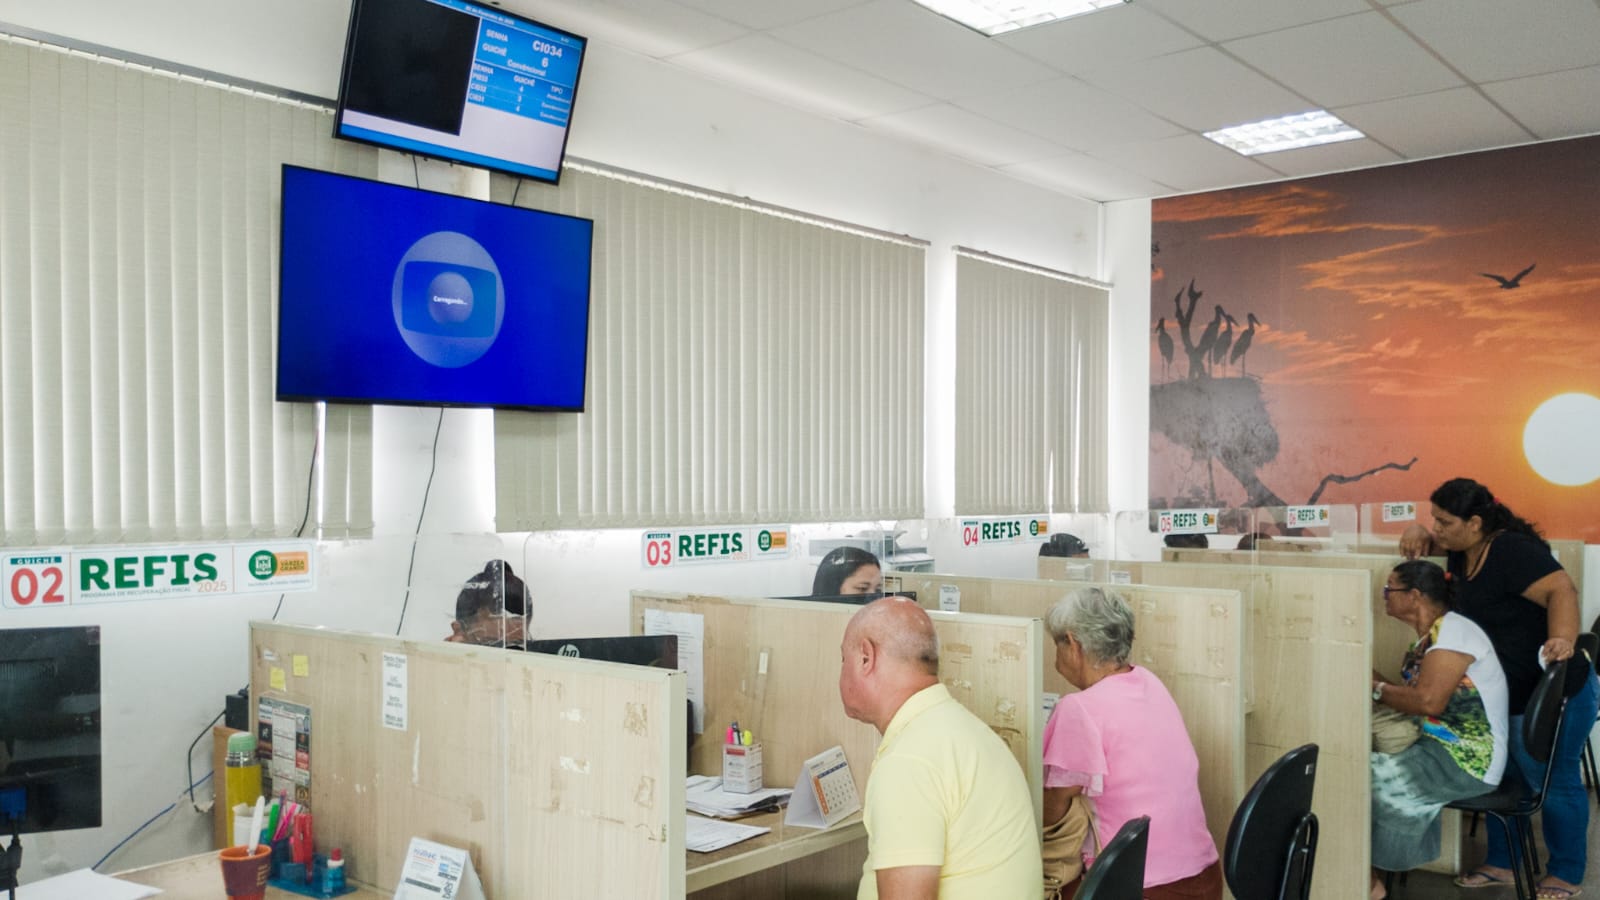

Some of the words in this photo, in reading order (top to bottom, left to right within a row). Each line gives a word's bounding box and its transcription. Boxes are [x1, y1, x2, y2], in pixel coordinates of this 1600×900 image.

[486, 29, 508, 42] SENHA
[532, 40, 562, 58] CI034
[541, 57, 549, 68] 6
[472, 63, 494, 75] SENHA
[551, 85, 563, 94] TIPO
[1173, 513, 1197, 527] REFIS
[1297, 509, 1315, 521] REFIS
[963, 526, 979, 546] 04
[982, 521, 1021, 540] REFIS
[646, 540, 672, 566] 03
[678, 532, 743, 557] REFIS
[11, 567, 64, 605] 02
[80, 552, 218, 591] REFIS
[80, 591, 116, 599] PROGRAMA
[198, 581, 227, 593] 2025
